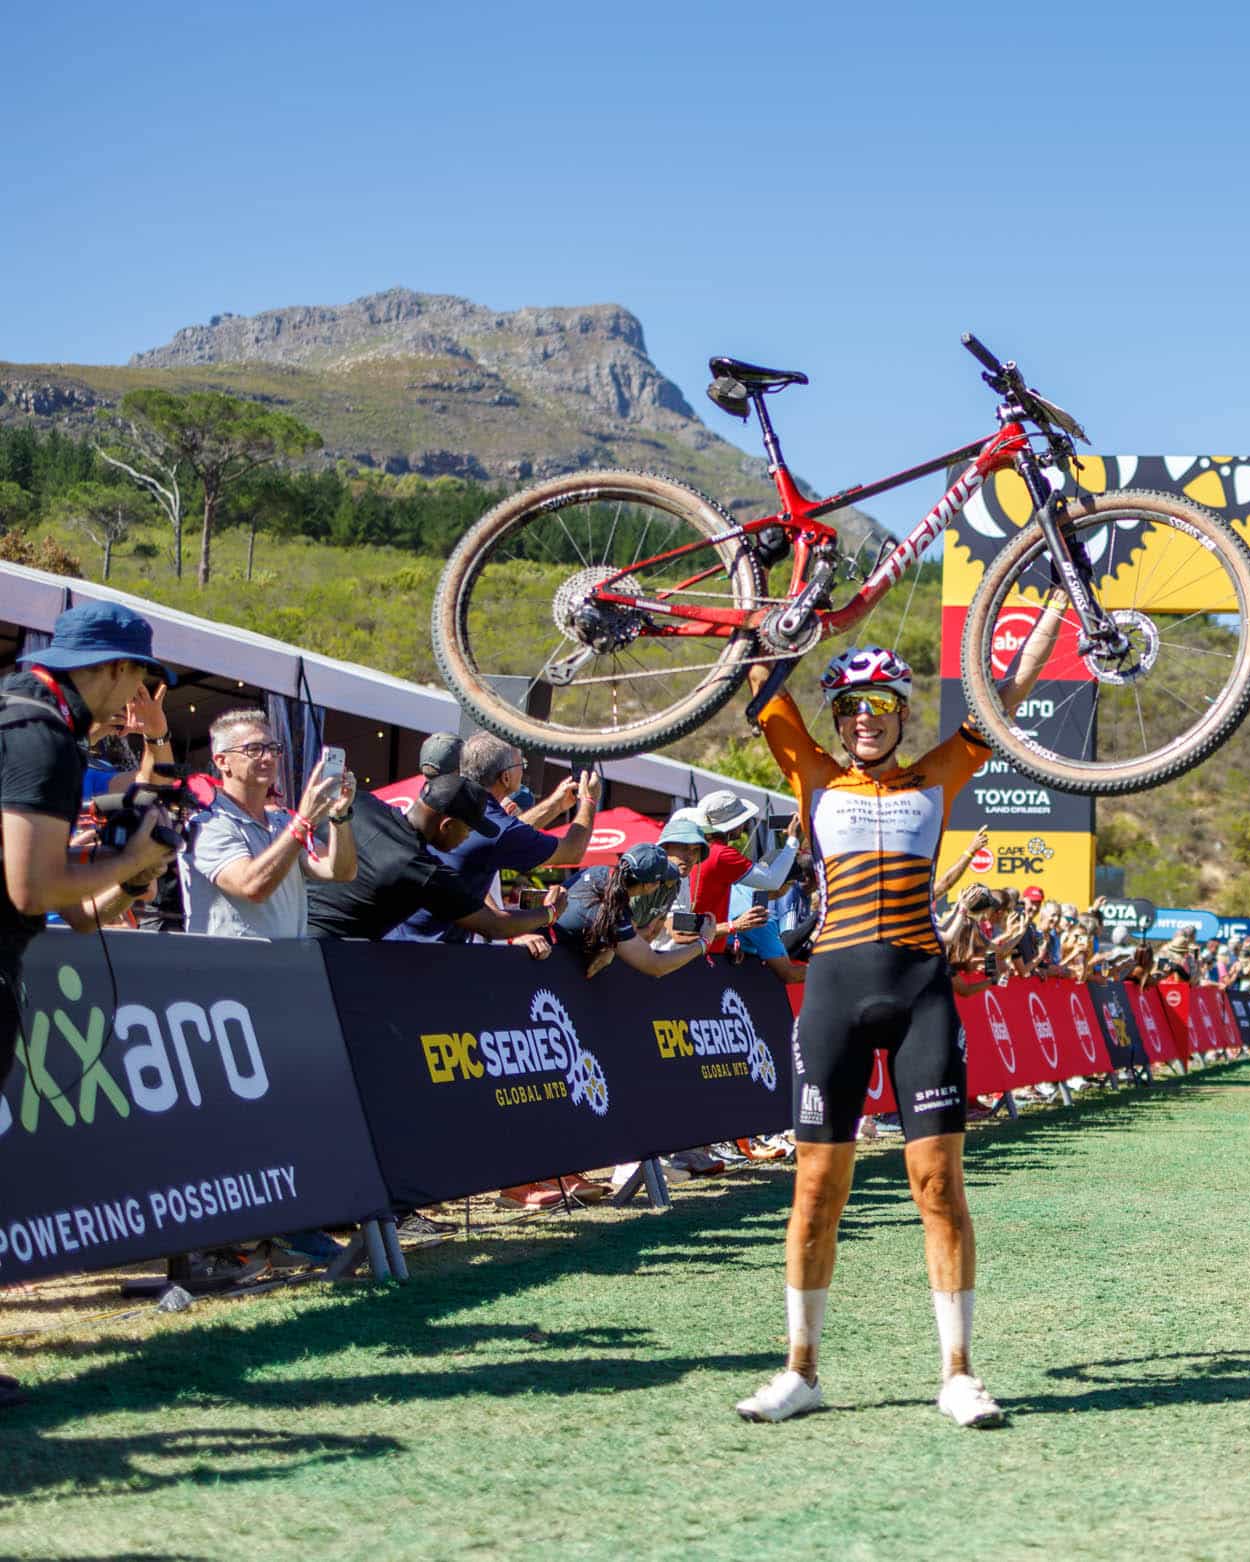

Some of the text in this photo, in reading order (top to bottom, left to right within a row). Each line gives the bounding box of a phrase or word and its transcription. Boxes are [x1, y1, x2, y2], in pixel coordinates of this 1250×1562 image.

[994, 629, 1026, 651] abs
[974, 789, 1050, 805] TOYOTA
[997, 846, 1025, 855] CAPE
[997, 857, 1044, 874] EPIC
[1099, 904, 1137, 919] OTA
[0, 1000, 269, 1135] xxaro
[701, 1061, 749, 1080] GLOBAL MTB
[494, 1080, 568, 1106] GLOBAL MTB
[915, 1086, 958, 1101] SPIER
[150, 1165, 297, 1229] POSSIBILITY
